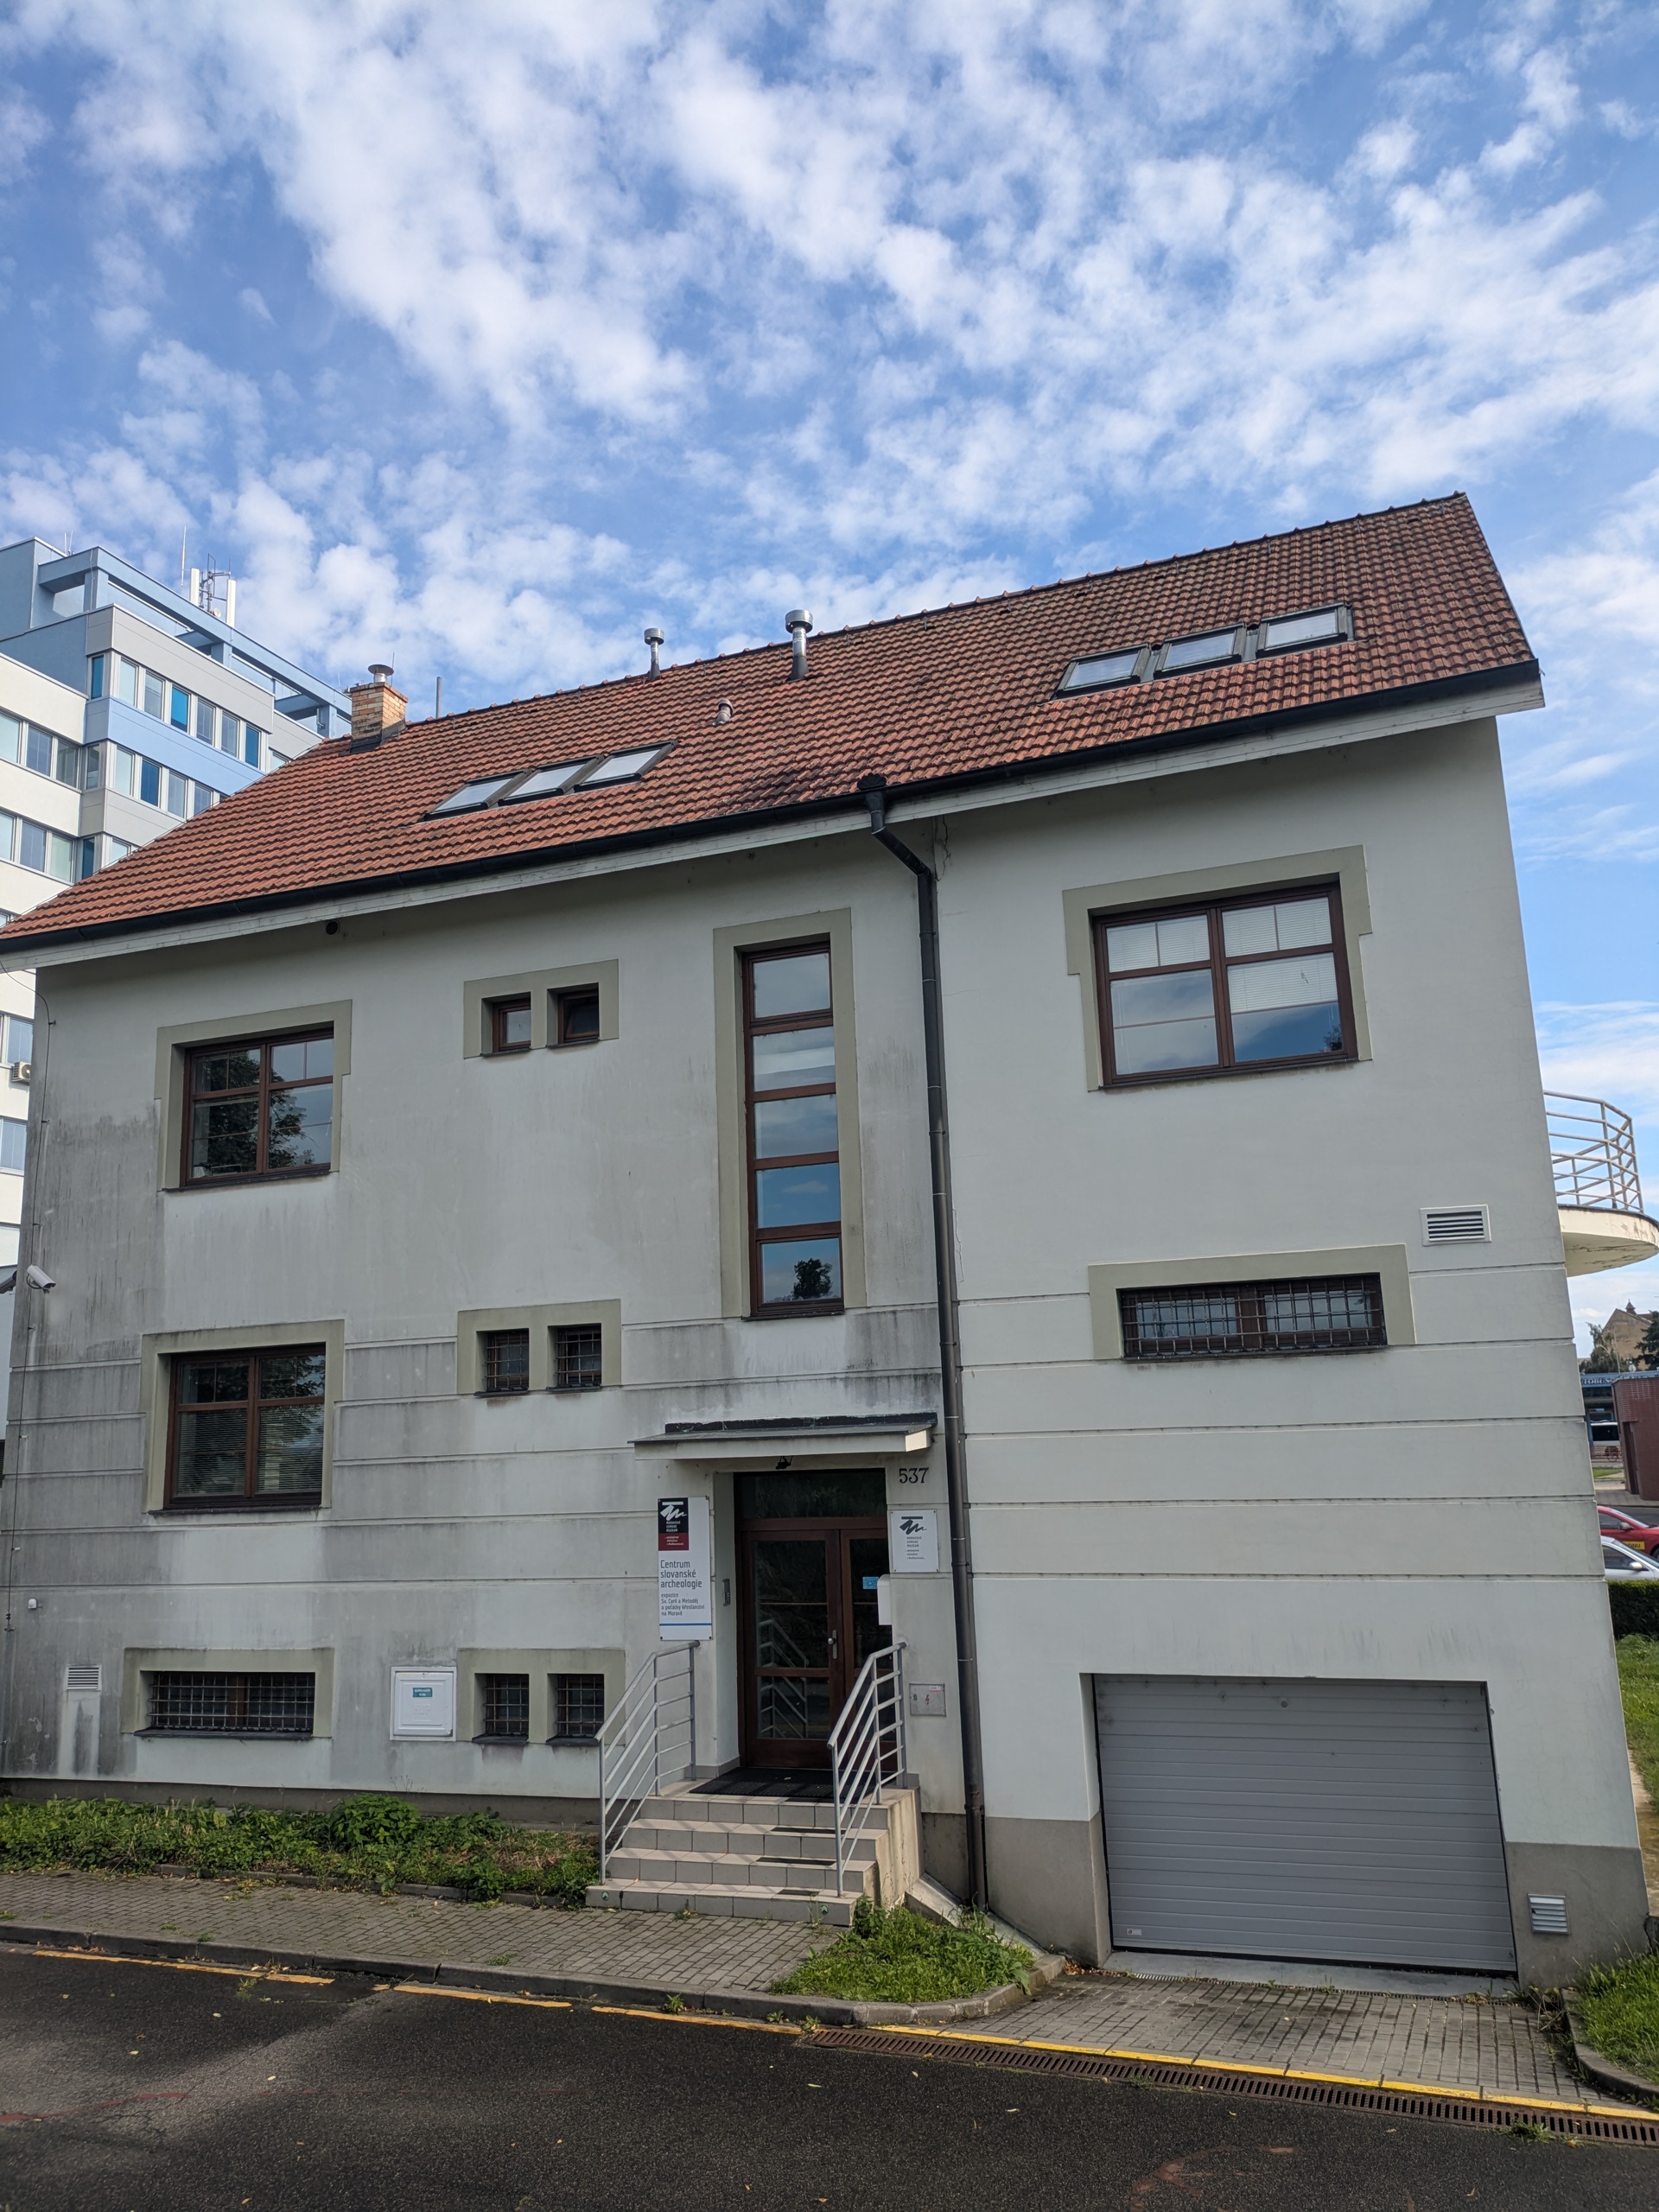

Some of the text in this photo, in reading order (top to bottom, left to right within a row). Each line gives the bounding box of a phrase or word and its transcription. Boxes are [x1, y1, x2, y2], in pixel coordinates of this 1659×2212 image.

[899, 1467, 929, 1484] 537
[661, 1560, 690, 1568] Centrum
[660, 1569, 696, 1578] slovanské
[661, 1580, 702, 1590] archeologie
